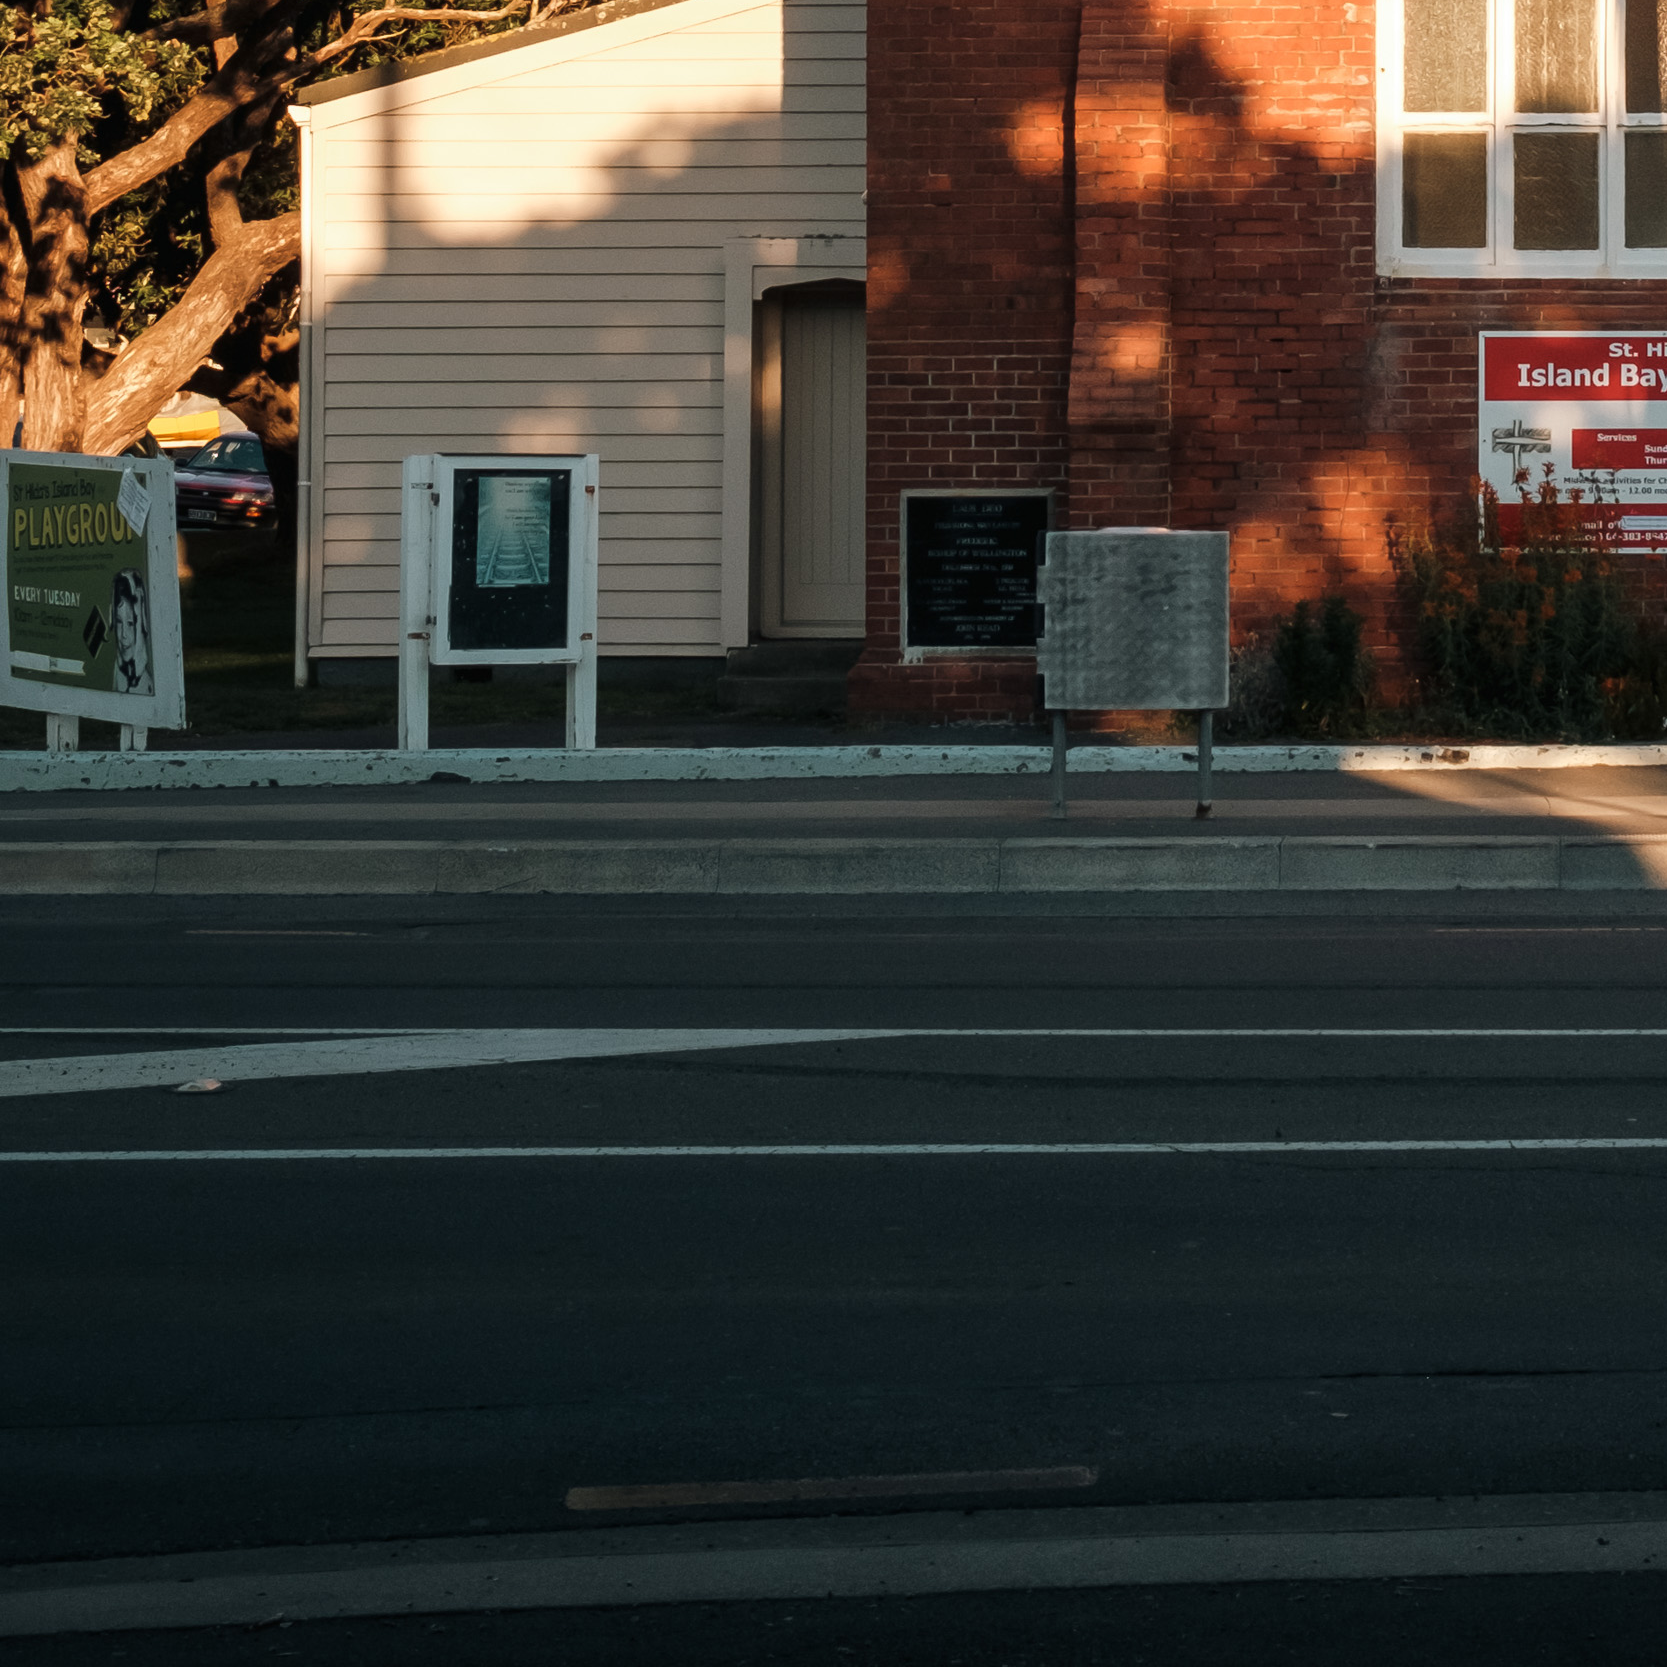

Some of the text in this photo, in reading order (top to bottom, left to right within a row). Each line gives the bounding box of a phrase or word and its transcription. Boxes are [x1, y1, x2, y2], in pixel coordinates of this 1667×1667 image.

[1608, 342, 1639, 357] St.
[1517, 362, 1610, 387] Island
[1597, 433, 1638, 442] Services
[52, 480, 78, 499] Island
[80, 478, 96, 499] Bay
[14, 584, 81, 608] EVERY TUESDAY
